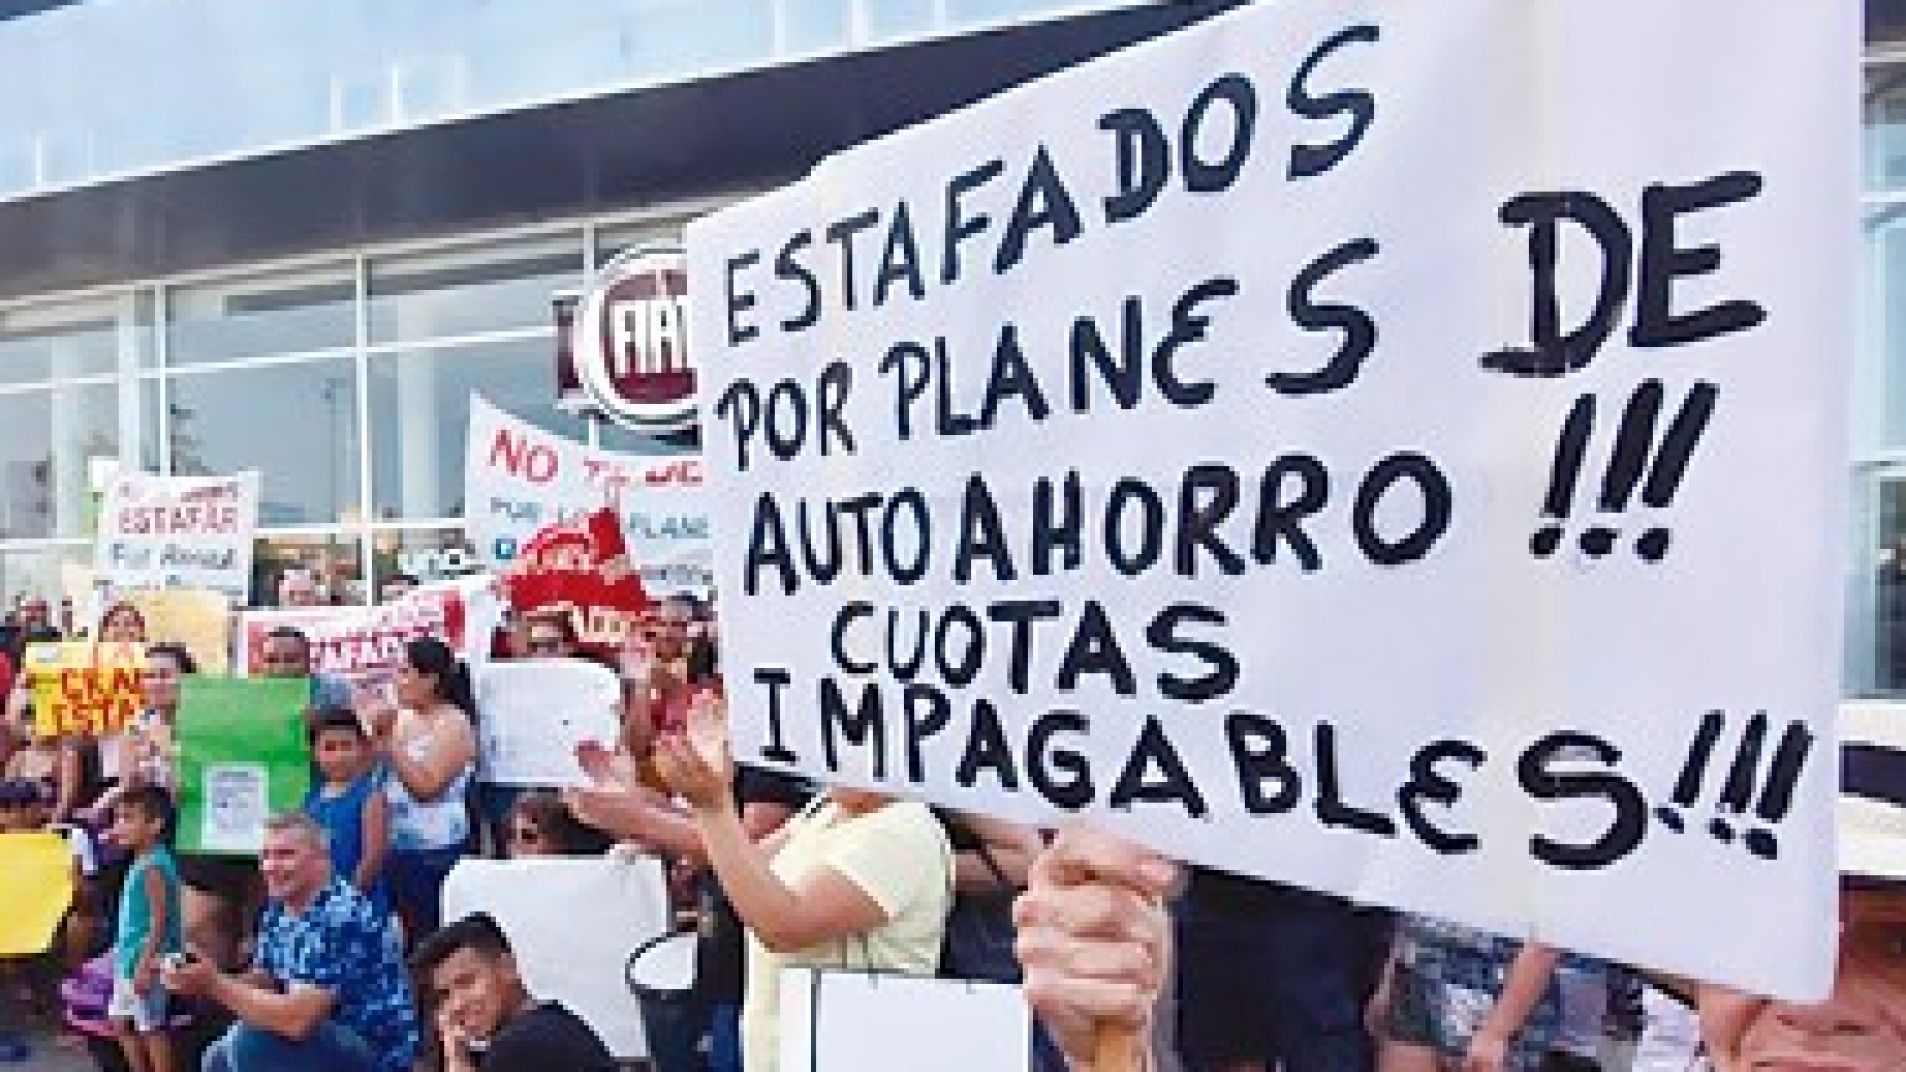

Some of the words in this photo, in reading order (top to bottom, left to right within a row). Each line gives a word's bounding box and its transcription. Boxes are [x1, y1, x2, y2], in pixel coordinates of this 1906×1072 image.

[727, 25, 1380, 346] ESTAFADOS
[715, 360, 857, 472] POR
[877, 237, 1380, 442] PLANES
[1480, 170, 1768, 379] DE
[489, 428, 560, 483] NO
[830, 599, 1241, 705] CUOTAS
